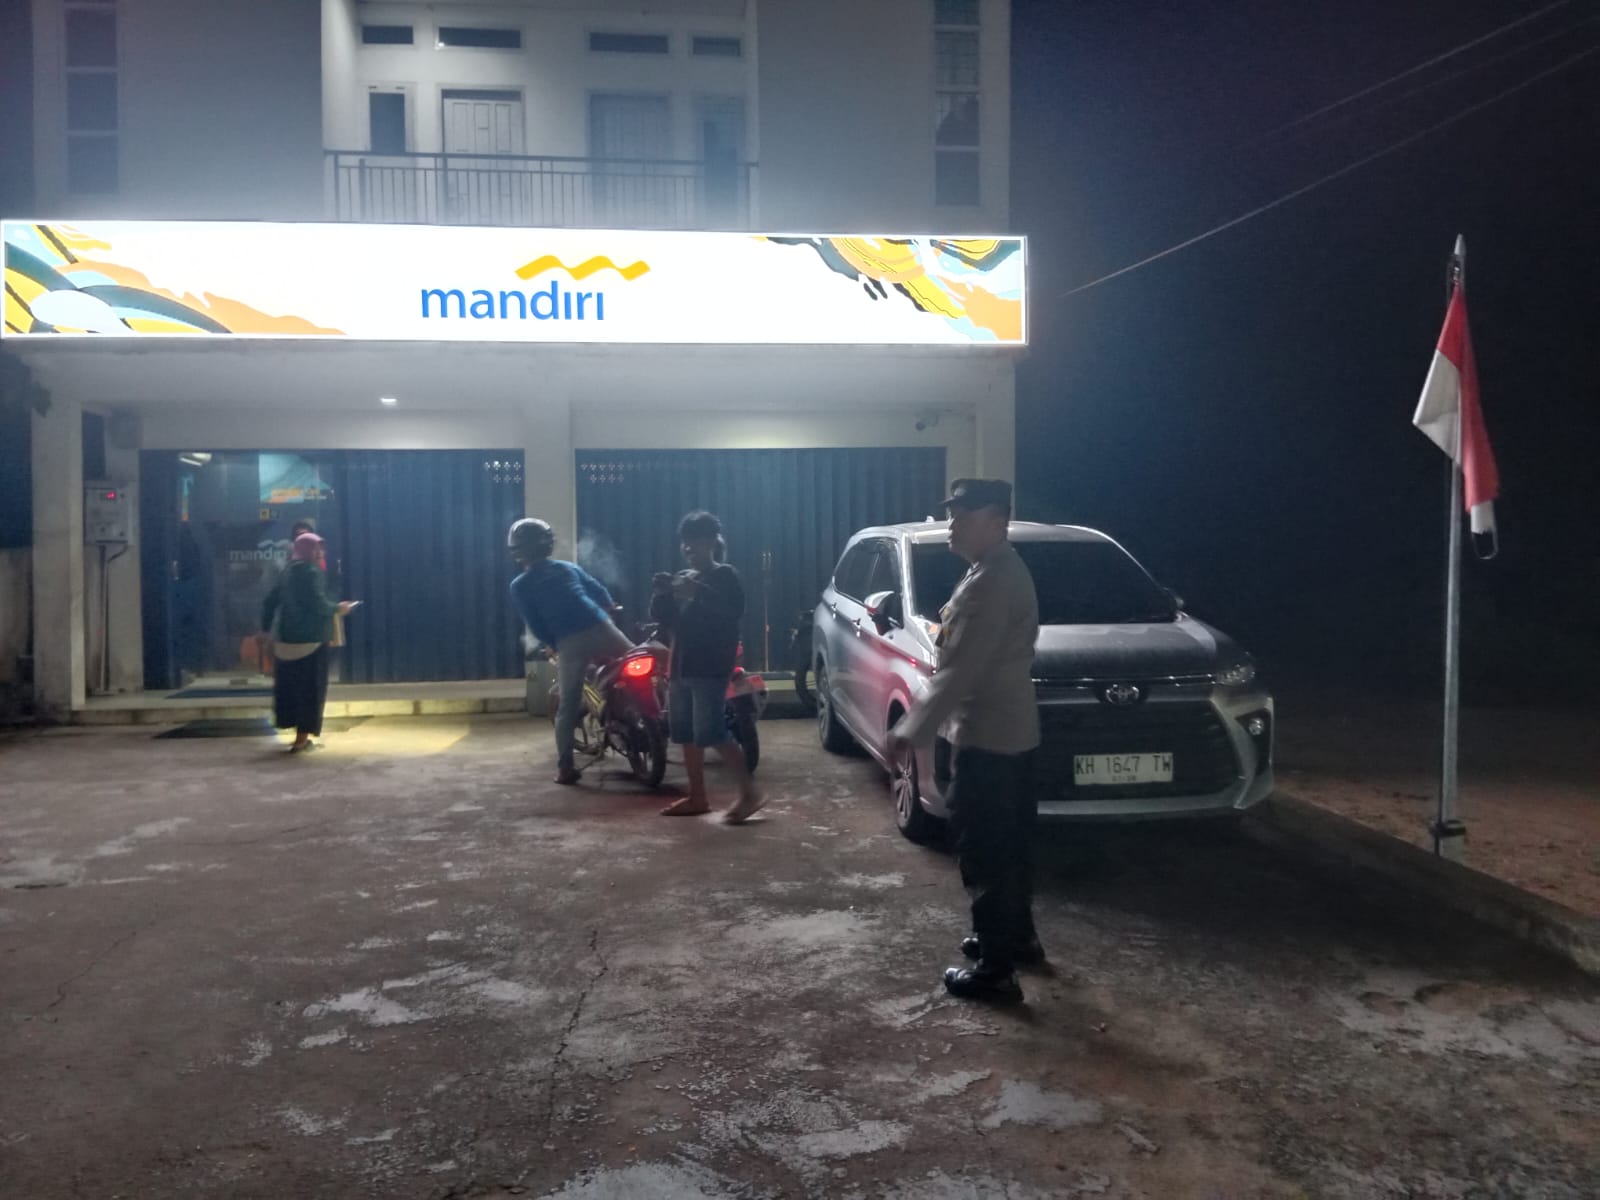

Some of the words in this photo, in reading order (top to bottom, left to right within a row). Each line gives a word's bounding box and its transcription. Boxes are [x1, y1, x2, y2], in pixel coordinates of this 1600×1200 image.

[421, 280, 605, 321] mandiri
[1075, 756, 1095, 775] KH
[1105, 755, 1141, 774] 1647
[1152, 753, 1173, 772] TW
